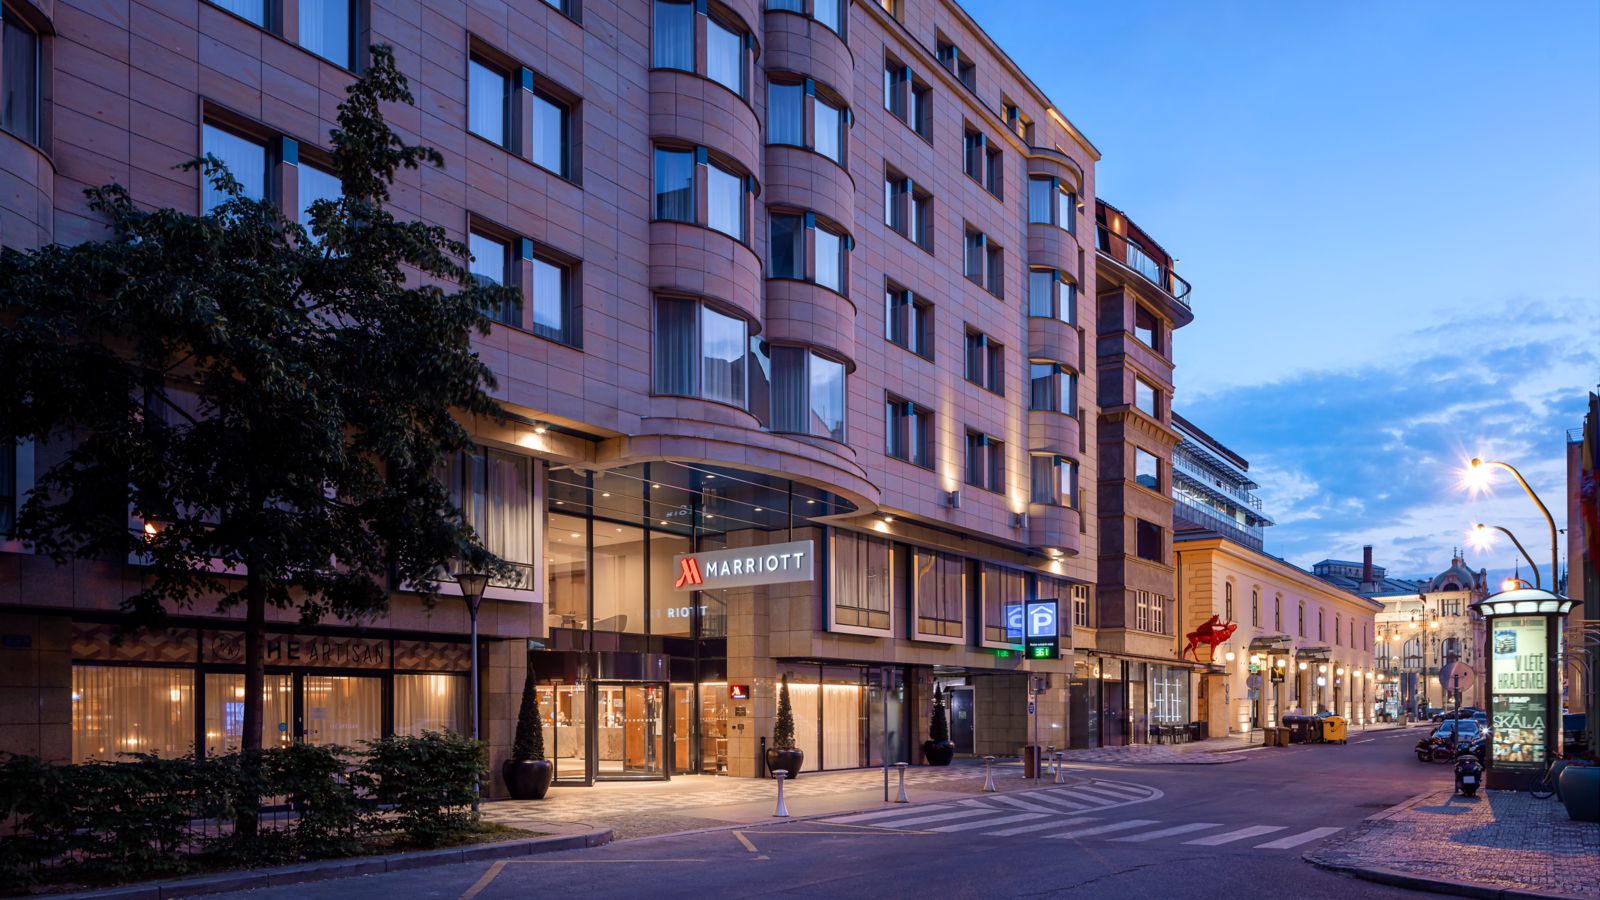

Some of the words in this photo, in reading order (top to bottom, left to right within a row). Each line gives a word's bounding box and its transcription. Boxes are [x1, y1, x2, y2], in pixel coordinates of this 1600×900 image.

[706, 552, 805, 577] MARRIOTT
[1033, 613, 1052, 635] P
[266, 639, 301, 660] HE
[309, 642, 384, 663] ARTISAN
